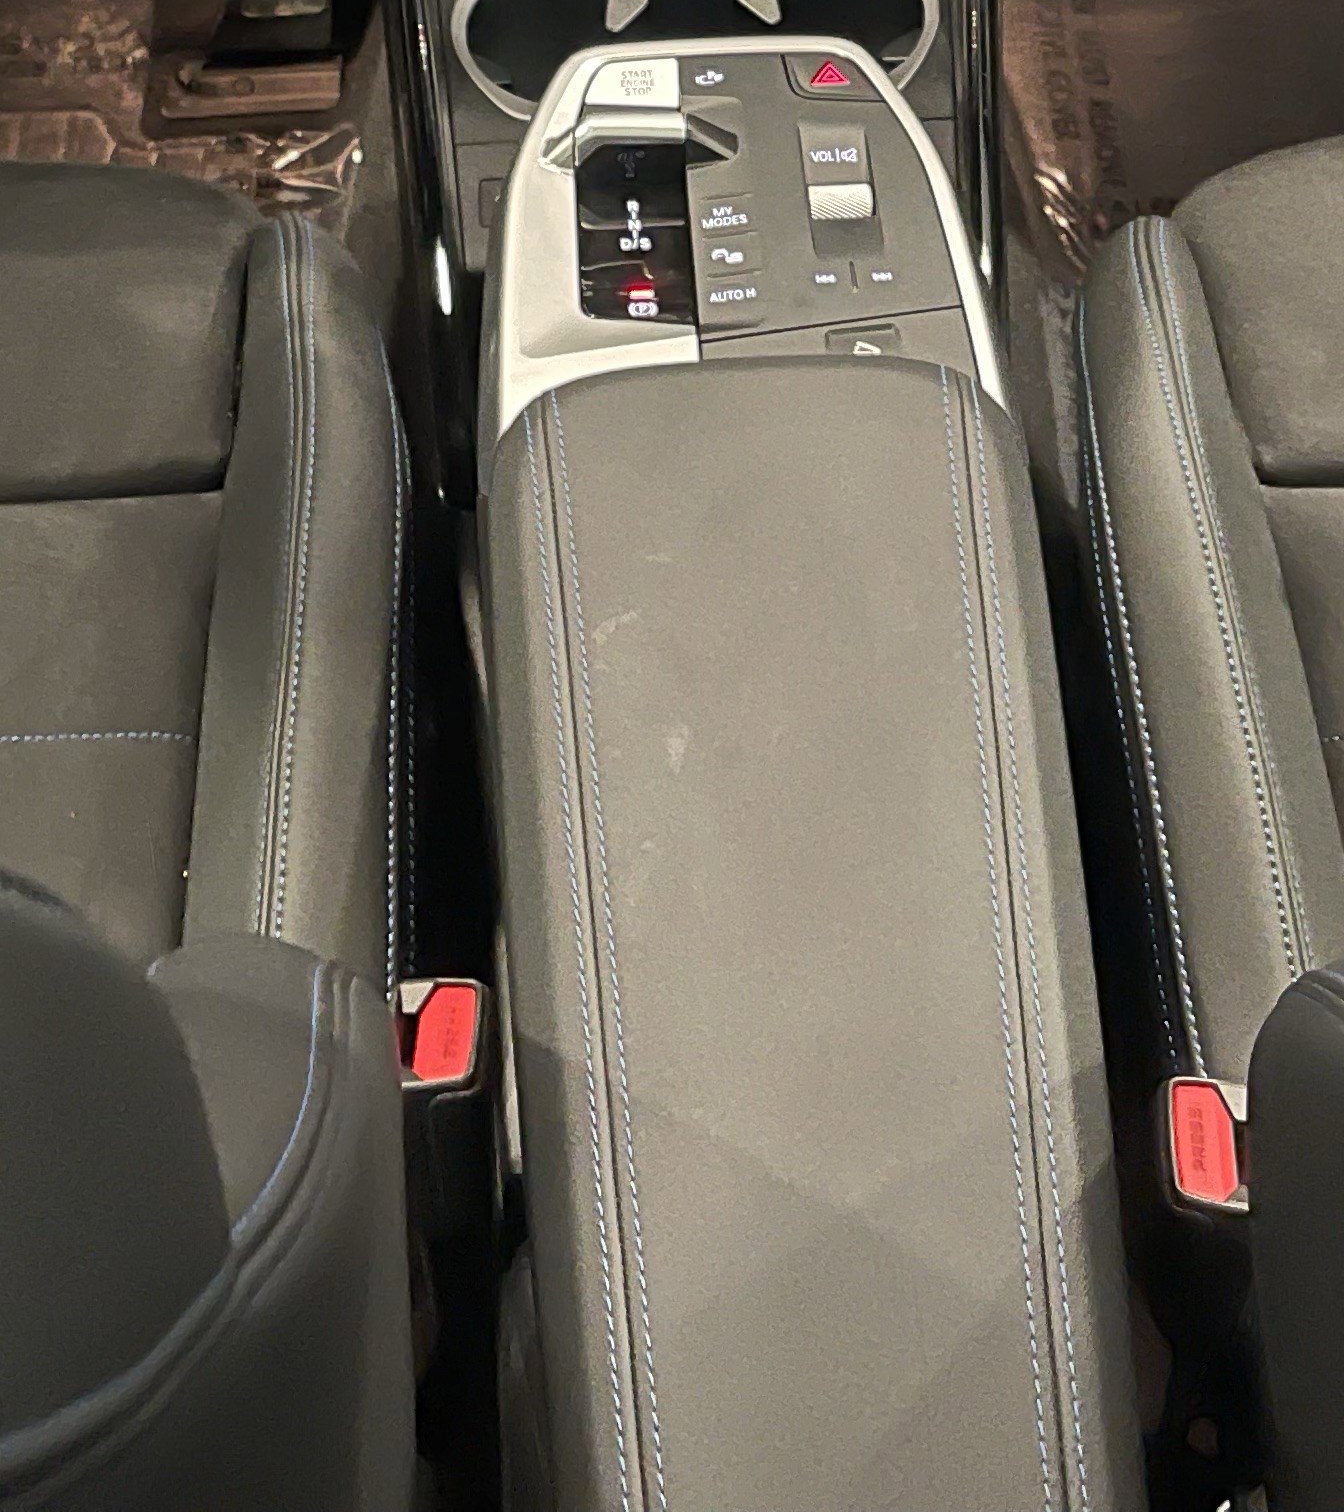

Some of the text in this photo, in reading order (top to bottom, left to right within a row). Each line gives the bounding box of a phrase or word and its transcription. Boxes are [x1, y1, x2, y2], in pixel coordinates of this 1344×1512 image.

[621, 69, 654, 80] START
[620, 78, 655, 88] ENGINE
[624, 86, 652, 97] STOP
[810, 150, 835, 163] VOL
[626, 199, 640, 213] R
[712, 206, 734, 218] MY
[628, 218, 643, 232] N
[701, 212, 749, 230] MODES
[709, 287, 757, 304] AUTO H
